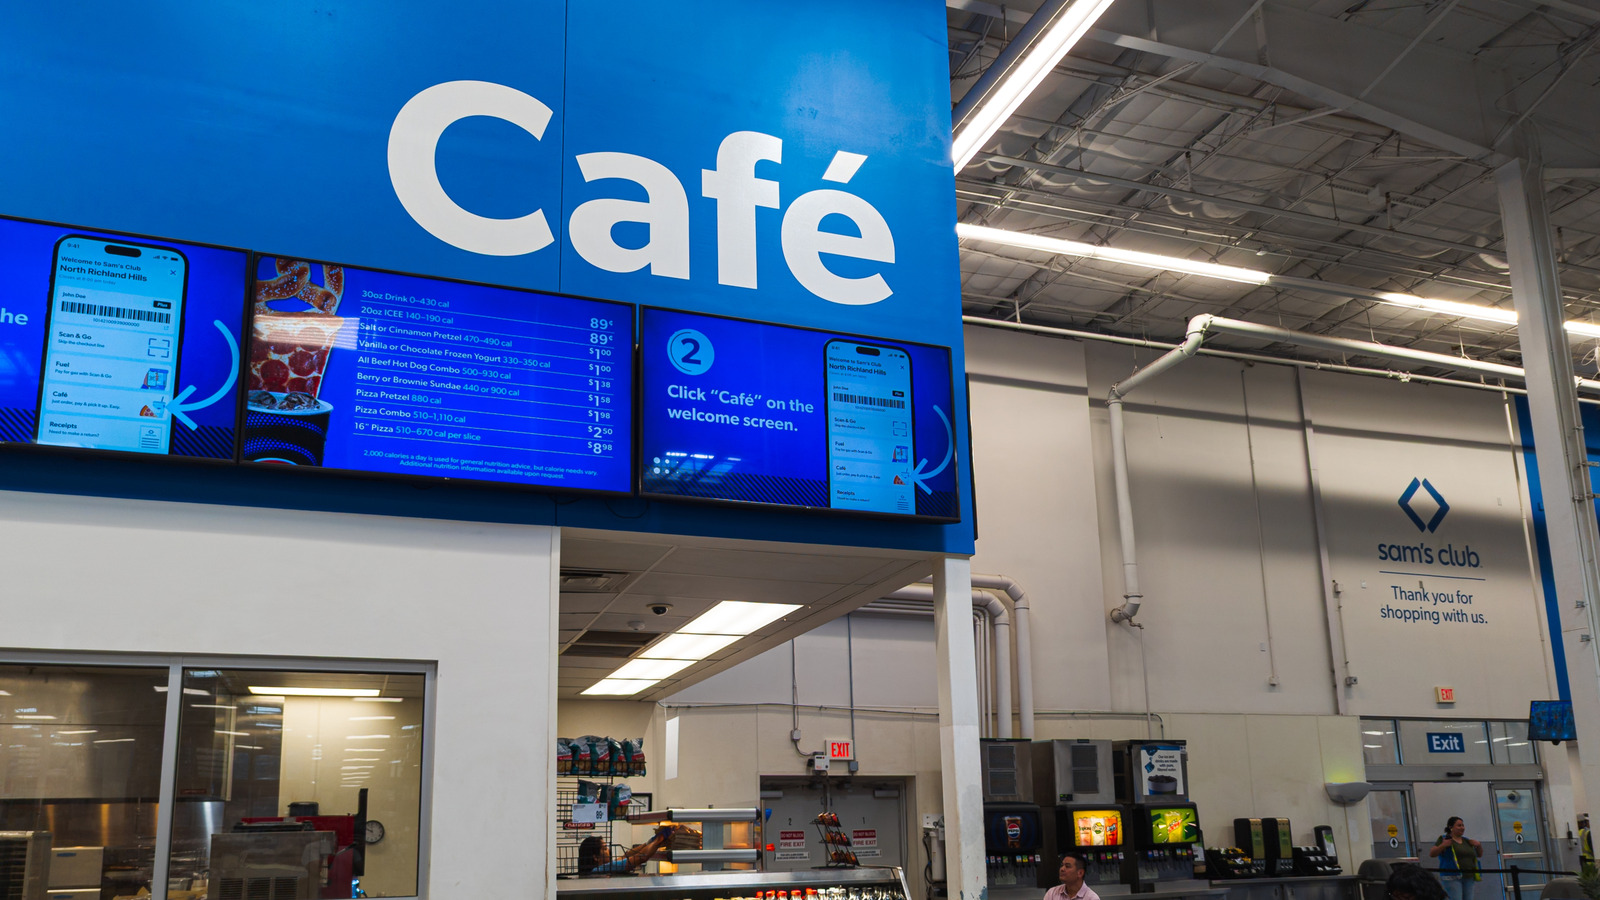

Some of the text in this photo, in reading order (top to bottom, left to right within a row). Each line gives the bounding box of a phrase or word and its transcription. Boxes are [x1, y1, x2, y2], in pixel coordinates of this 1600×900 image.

[387, 79, 896, 306] Café
[61, 256, 93, 265] Welcome
[103, 261, 124, 269] Sam's
[60, 264, 86, 274] North
[88, 268, 127, 279] Richland
[128, 273, 147, 282] Hills
[361, 290, 383, 300] 30oz
[385, 293, 408, 303] Drink
[0, 307, 29, 326] he
[361, 306, 383, 316] 20oz
[384, 309, 404, 318] ICEE
[441, 316, 454, 324] cal
[58, 331, 74, 339] Scan
[359, 322, 377, 331] Salt
[388, 325, 432, 338] Cinnamon
[433, 331, 462, 341] Pretzel
[501, 340, 512, 348] cal
[358, 339, 388, 350] Vanilla
[400, 344, 443, 356] Chocolate
[444, 349, 473, 360] Frozen
[473, 352, 501, 363] Yogurt
[681, 337, 702, 366] 2
[357, 356, 370, 364] All
[371, 357, 391, 366] Beef
[392, 360, 409, 368] Hot
[409, 361, 428, 372] Dog
[429, 363, 461, 374] Combo
[499, 372, 512, 380] cal
[829, 363, 847, 371] North
[847, 365, 873, 374] Richland
[357, 372, 381, 383] Berry
[393, 376, 429, 388] Brownie
[429, 380, 462, 391] Sundae
[462, 384, 480, 392] 440
[490, 386, 507, 395] 900
[356, 389, 379, 398] Pizza
[380, 391, 410, 401] Pretzel
[411, 394, 429, 403] 880
[667, 384, 706, 401] Click
[766, 398, 786, 410] on
[789, 398, 814, 413] the
[355, 405, 378, 415] Pizza
[379, 407, 411, 418] Combo
[667, 407, 798, 432] welcome screen.
[49, 421, 77, 429] Receipts
[371, 423, 394, 433] Pizza
[434, 430, 446, 438] cal
[447, 432, 462, 440] per
[463, 432, 481, 441] slice
[384, 452, 410, 460] calories
[415, 454, 428, 462] day
[460, 458, 484, 467] general
[484, 460, 510, 468] nutrition
[545, 465, 565, 473] calorie
[399, 459, 433, 468] Additional
[433, 462, 460, 471] nutrition
[460, 464, 496, 473] information
[496, 468, 524, 476] available
[1378, 543, 1480, 568] sam's club
[1391, 585, 1473, 606] Thank you for
[1380, 604, 1488, 625] shopping with us.
[1441, 688, 1454, 701] EXIT
[831, 742, 850, 758] EXIT
[1431, 735, 1460, 751] Exit
